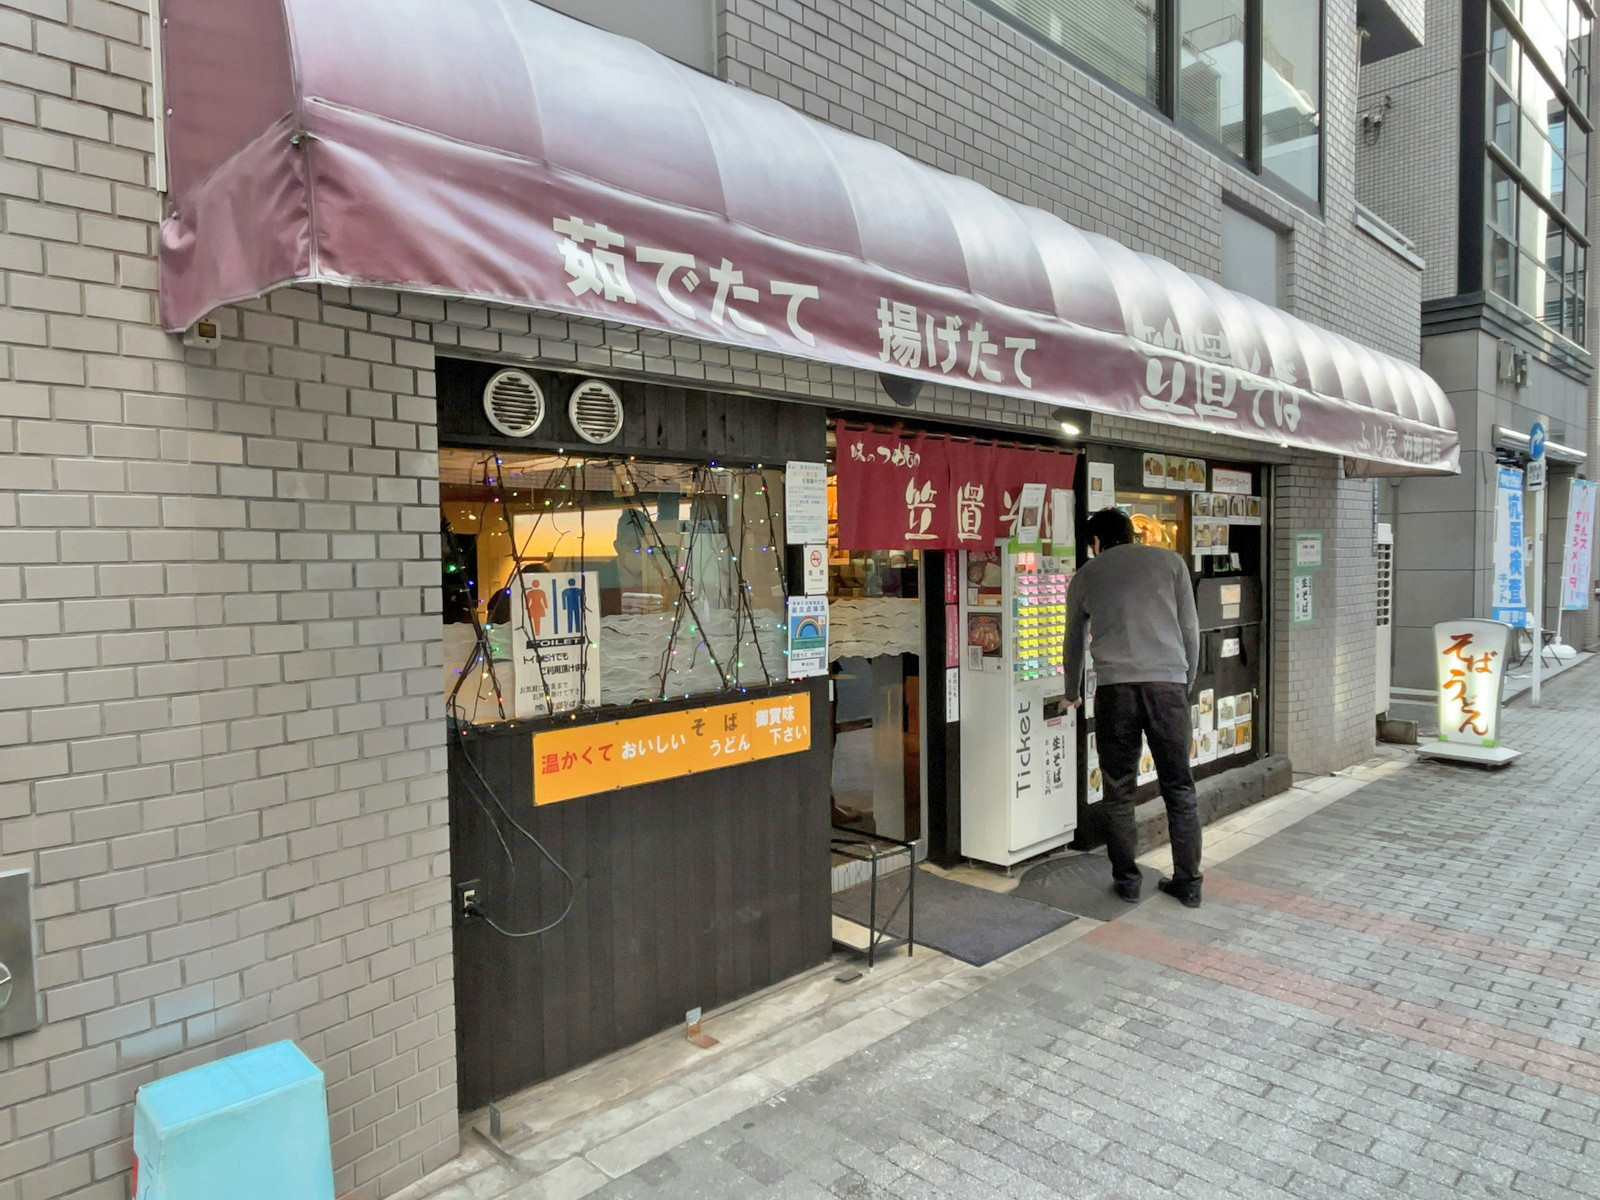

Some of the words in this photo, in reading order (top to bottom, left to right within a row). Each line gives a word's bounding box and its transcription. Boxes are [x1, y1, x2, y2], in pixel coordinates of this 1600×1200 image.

[552, 215, 820, 347] 茹でたて
[876, 297, 1036, 389] 揚げたて
[1508, 493, 1523, 604] 抗原検査
[523, 652, 569, 665] トイだけでも
[1443, 633, 1498, 674] そば
[755, 705, 795, 728] 御賞味
[1443, 669, 1489, 736] うどん
[691, 712, 738, 738] そば
[709, 734, 751, 757] うどん
[769, 725, 808, 746] 下さい
[541, 743, 614, 775] 温かくて
[620, 733, 686, 761] おいしい
[1016, 700, 1031, 798] Ticket
